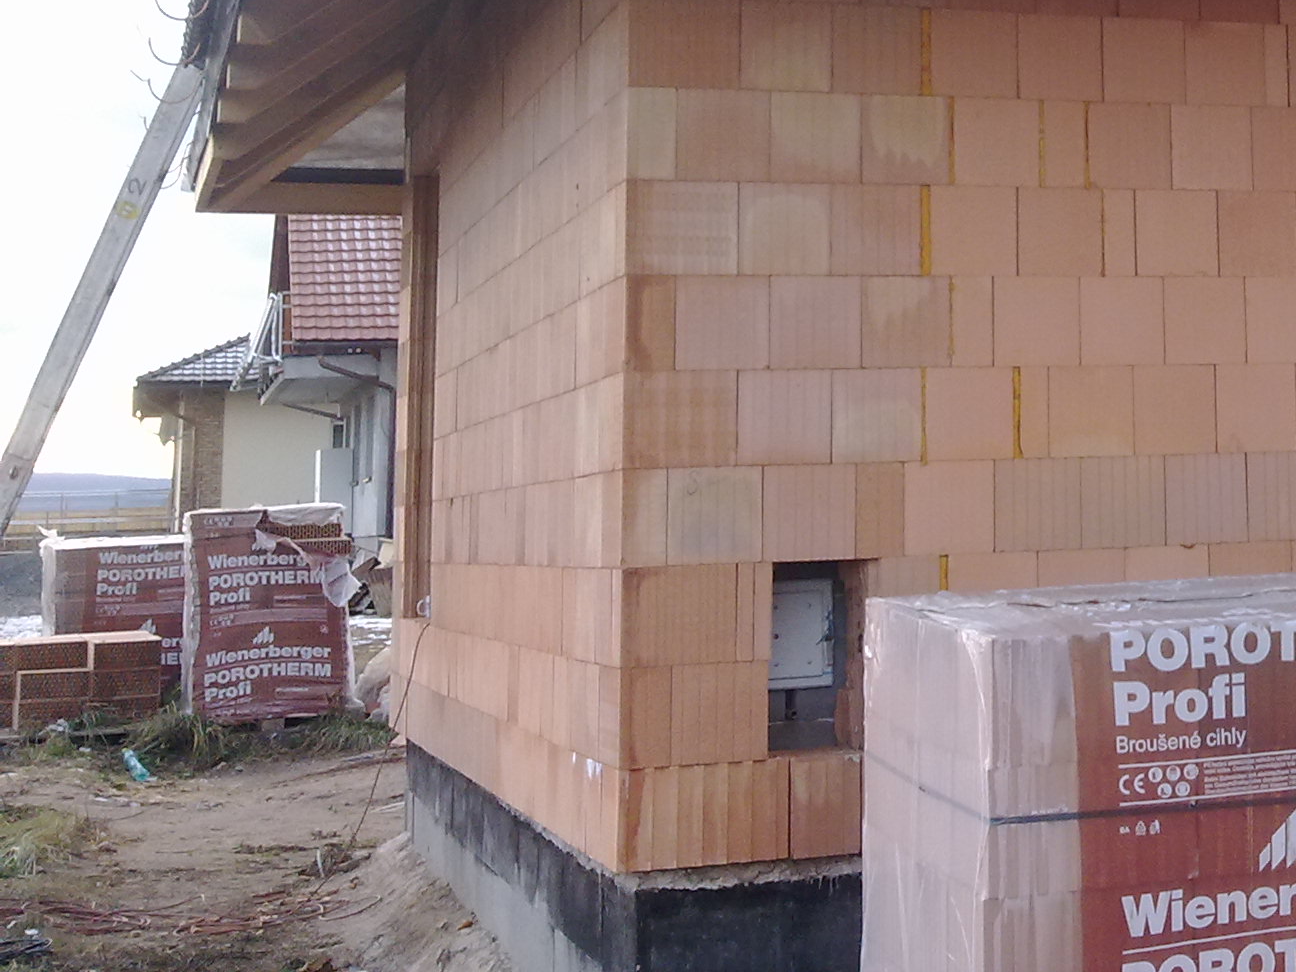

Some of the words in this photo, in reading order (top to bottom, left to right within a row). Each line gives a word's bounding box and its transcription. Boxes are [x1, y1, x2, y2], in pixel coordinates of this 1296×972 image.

[208, 553, 310, 570] Wienerberg
[96, 581, 138, 596] Profi
[209, 587, 251, 606] Profi
[205, 644, 332, 667] Wienerberger
[203, 662, 332, 688] POROTHERM
[204, 681, 252, 702] Profi
[1112, 672, 1246, 726] Profi
[1115, 730, 1202, 754] Broušené
[1206, 726, 1247, 748] cihly
